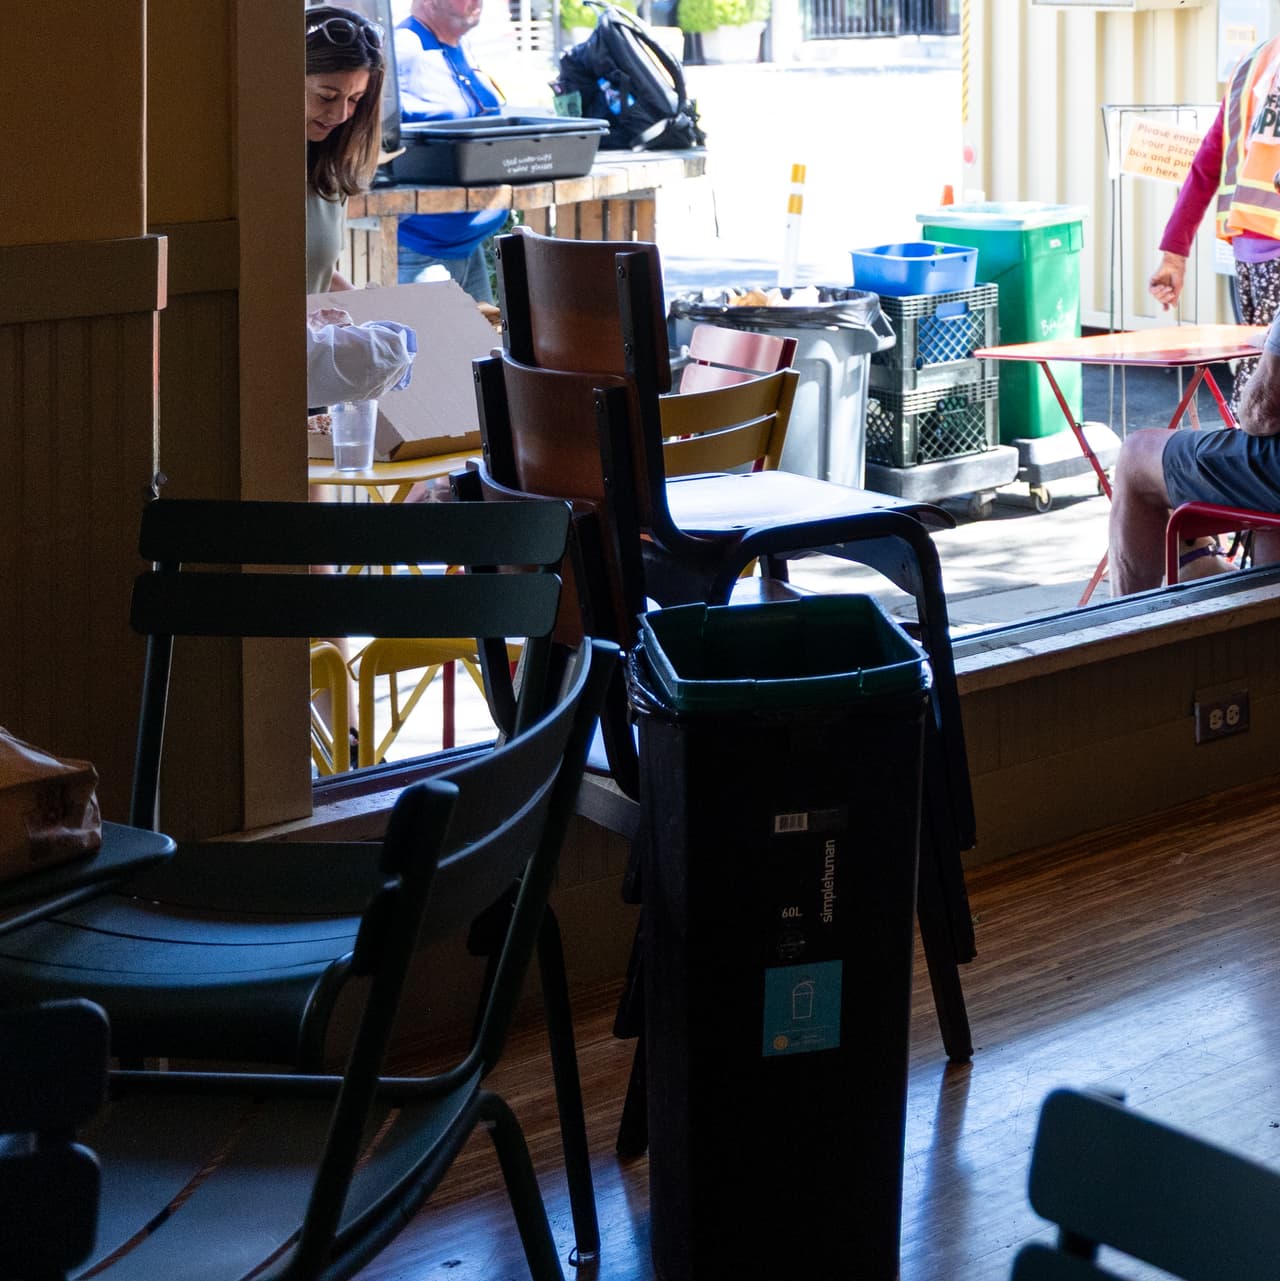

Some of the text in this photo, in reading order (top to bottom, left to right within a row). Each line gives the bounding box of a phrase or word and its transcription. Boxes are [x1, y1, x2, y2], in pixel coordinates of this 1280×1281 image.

[1129, 146, 1147, 158] box
[1151, 154, 1171, 164] and
[1142, 163, 1152, 173] in
[820, 838, 836, 924] simplehuman
[781, 906, 803, 919] 60L
